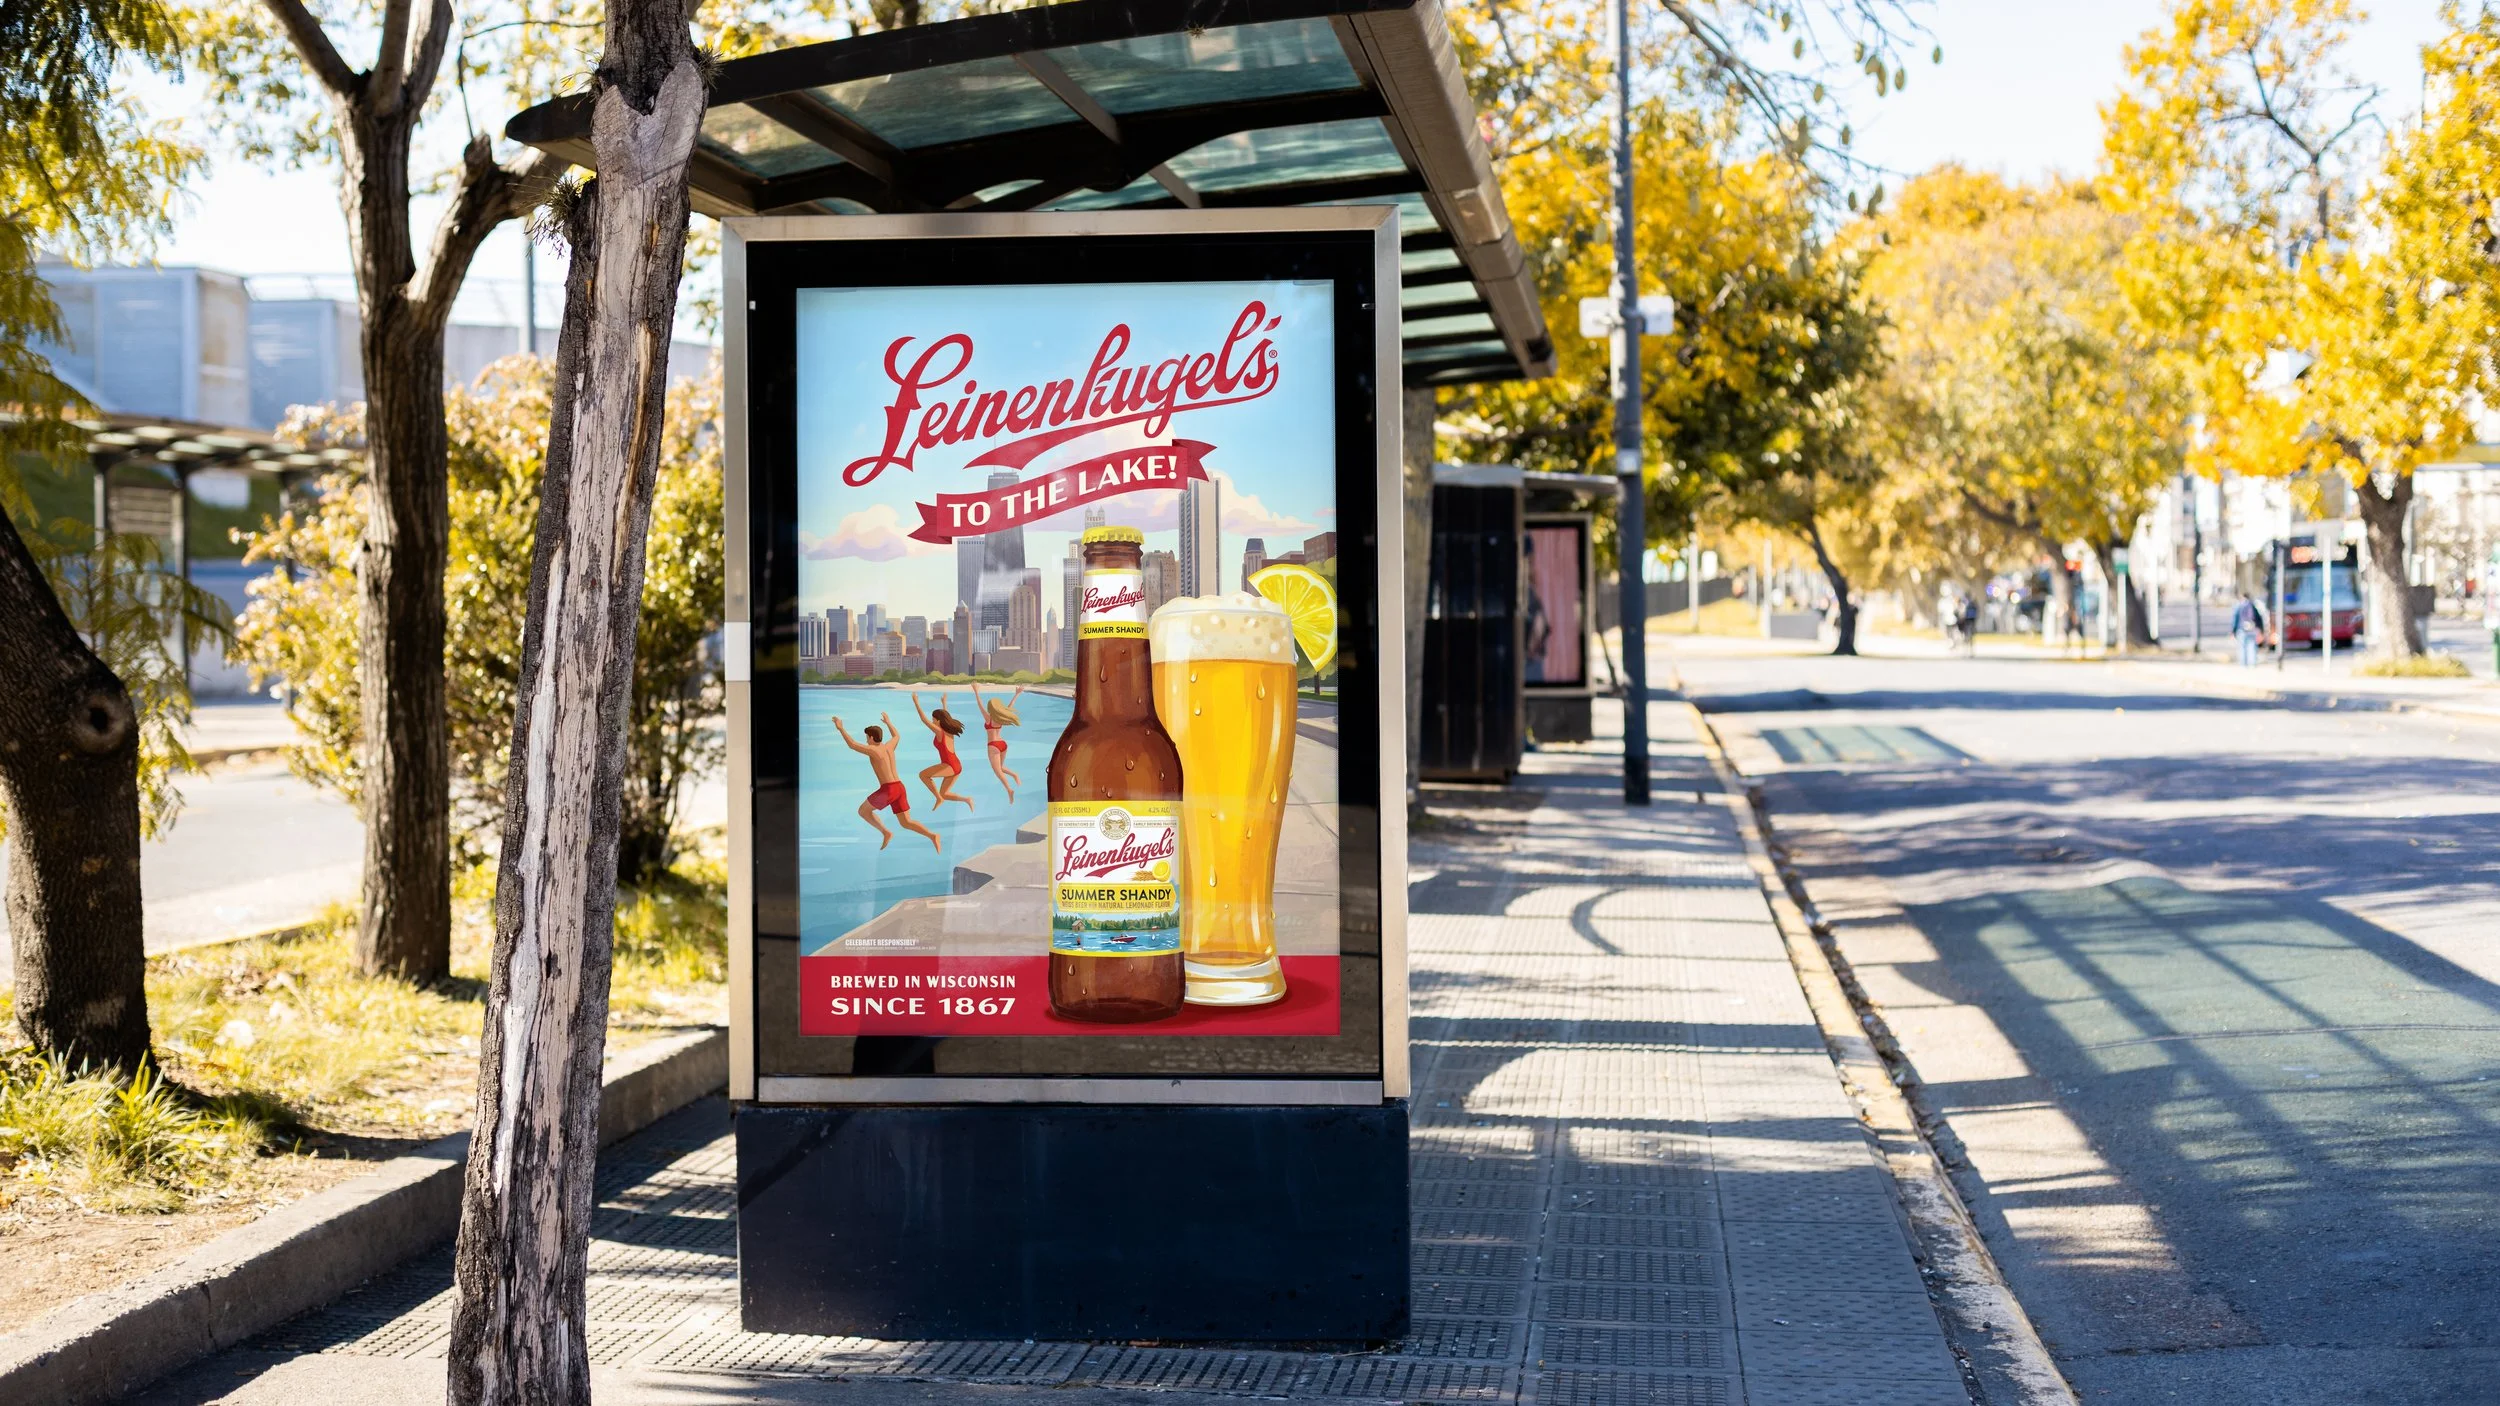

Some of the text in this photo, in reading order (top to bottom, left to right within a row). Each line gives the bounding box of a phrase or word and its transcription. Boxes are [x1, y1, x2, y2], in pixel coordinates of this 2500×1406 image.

[842, 300, 1282, 487] Leinenkugel's
[947, 455, 1178, 528] TO THE LAKE!
[1080, 582, 1145, 615] Leinenkugel
[1083, 626, 1145, 635] SUMMER SHANDY
[1055, 827, 1175, 881] Leinenkugel's
[1061, 888, 1171, 901] SUMMER SHANDY
[1098, 901, 1124, 909] NATURAL
[845, 938, 877, 946] CELEBRATE
[831, 975, 1016, 988] BREWED IN WISCONSIN
[831, 997, 1016, 1015] SINCE 1867
